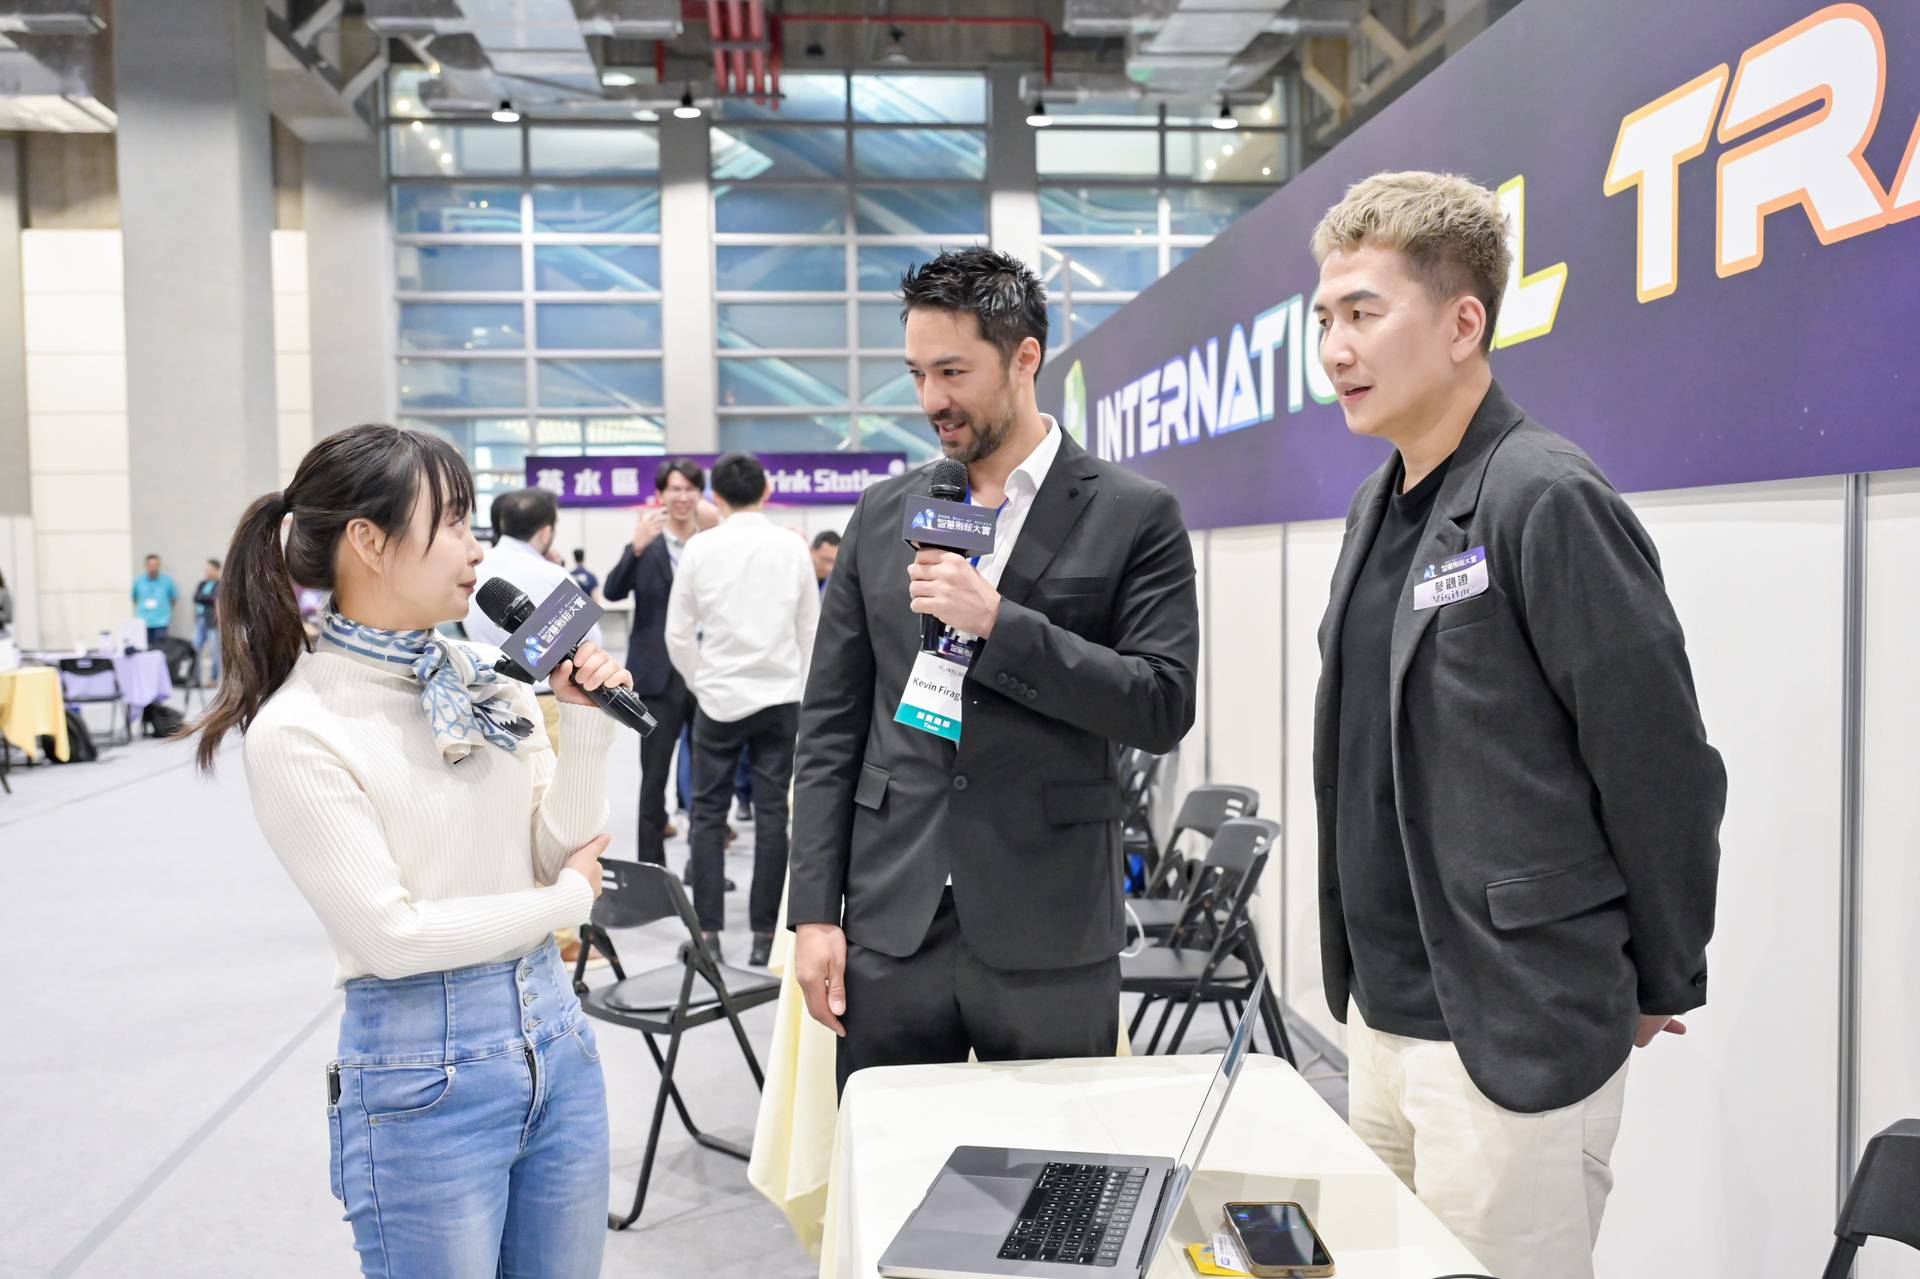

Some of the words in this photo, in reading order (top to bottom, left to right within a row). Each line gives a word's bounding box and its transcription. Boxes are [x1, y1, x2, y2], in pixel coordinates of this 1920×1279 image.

[1603, 2, 1920, 304] TR
[764, 468, 812, 494] rink
[813, 468, 892, 494] Stati
[1433, 588, 1470, 603] Visitor
[913, 677, 937, 692] Kevin
